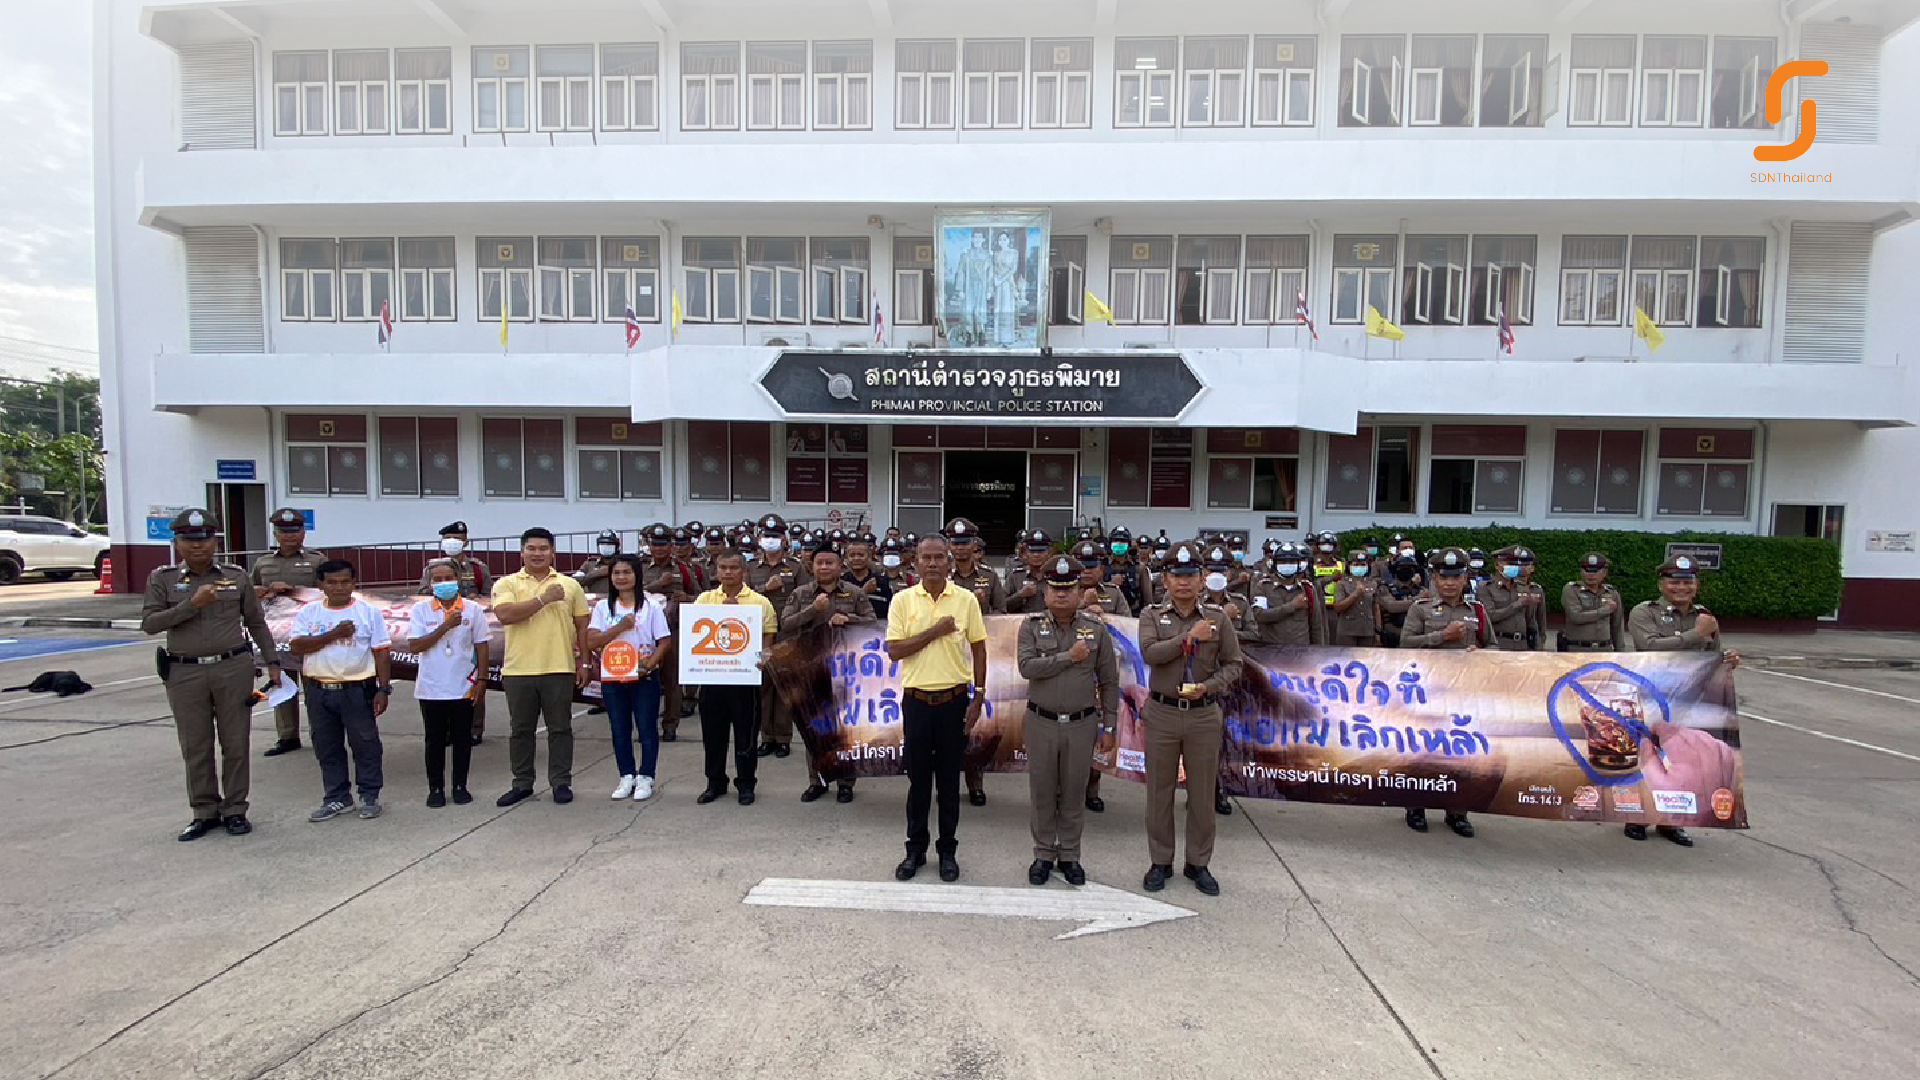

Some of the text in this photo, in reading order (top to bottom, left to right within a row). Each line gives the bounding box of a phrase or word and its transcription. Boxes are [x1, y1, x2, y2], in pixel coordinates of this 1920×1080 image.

[864, 360, 1121, 397] สถานีตำรวจภูธรพิมาย
[871, 400, 1103, 411] PHIMAI PROVINCIAL POLICE STATION
